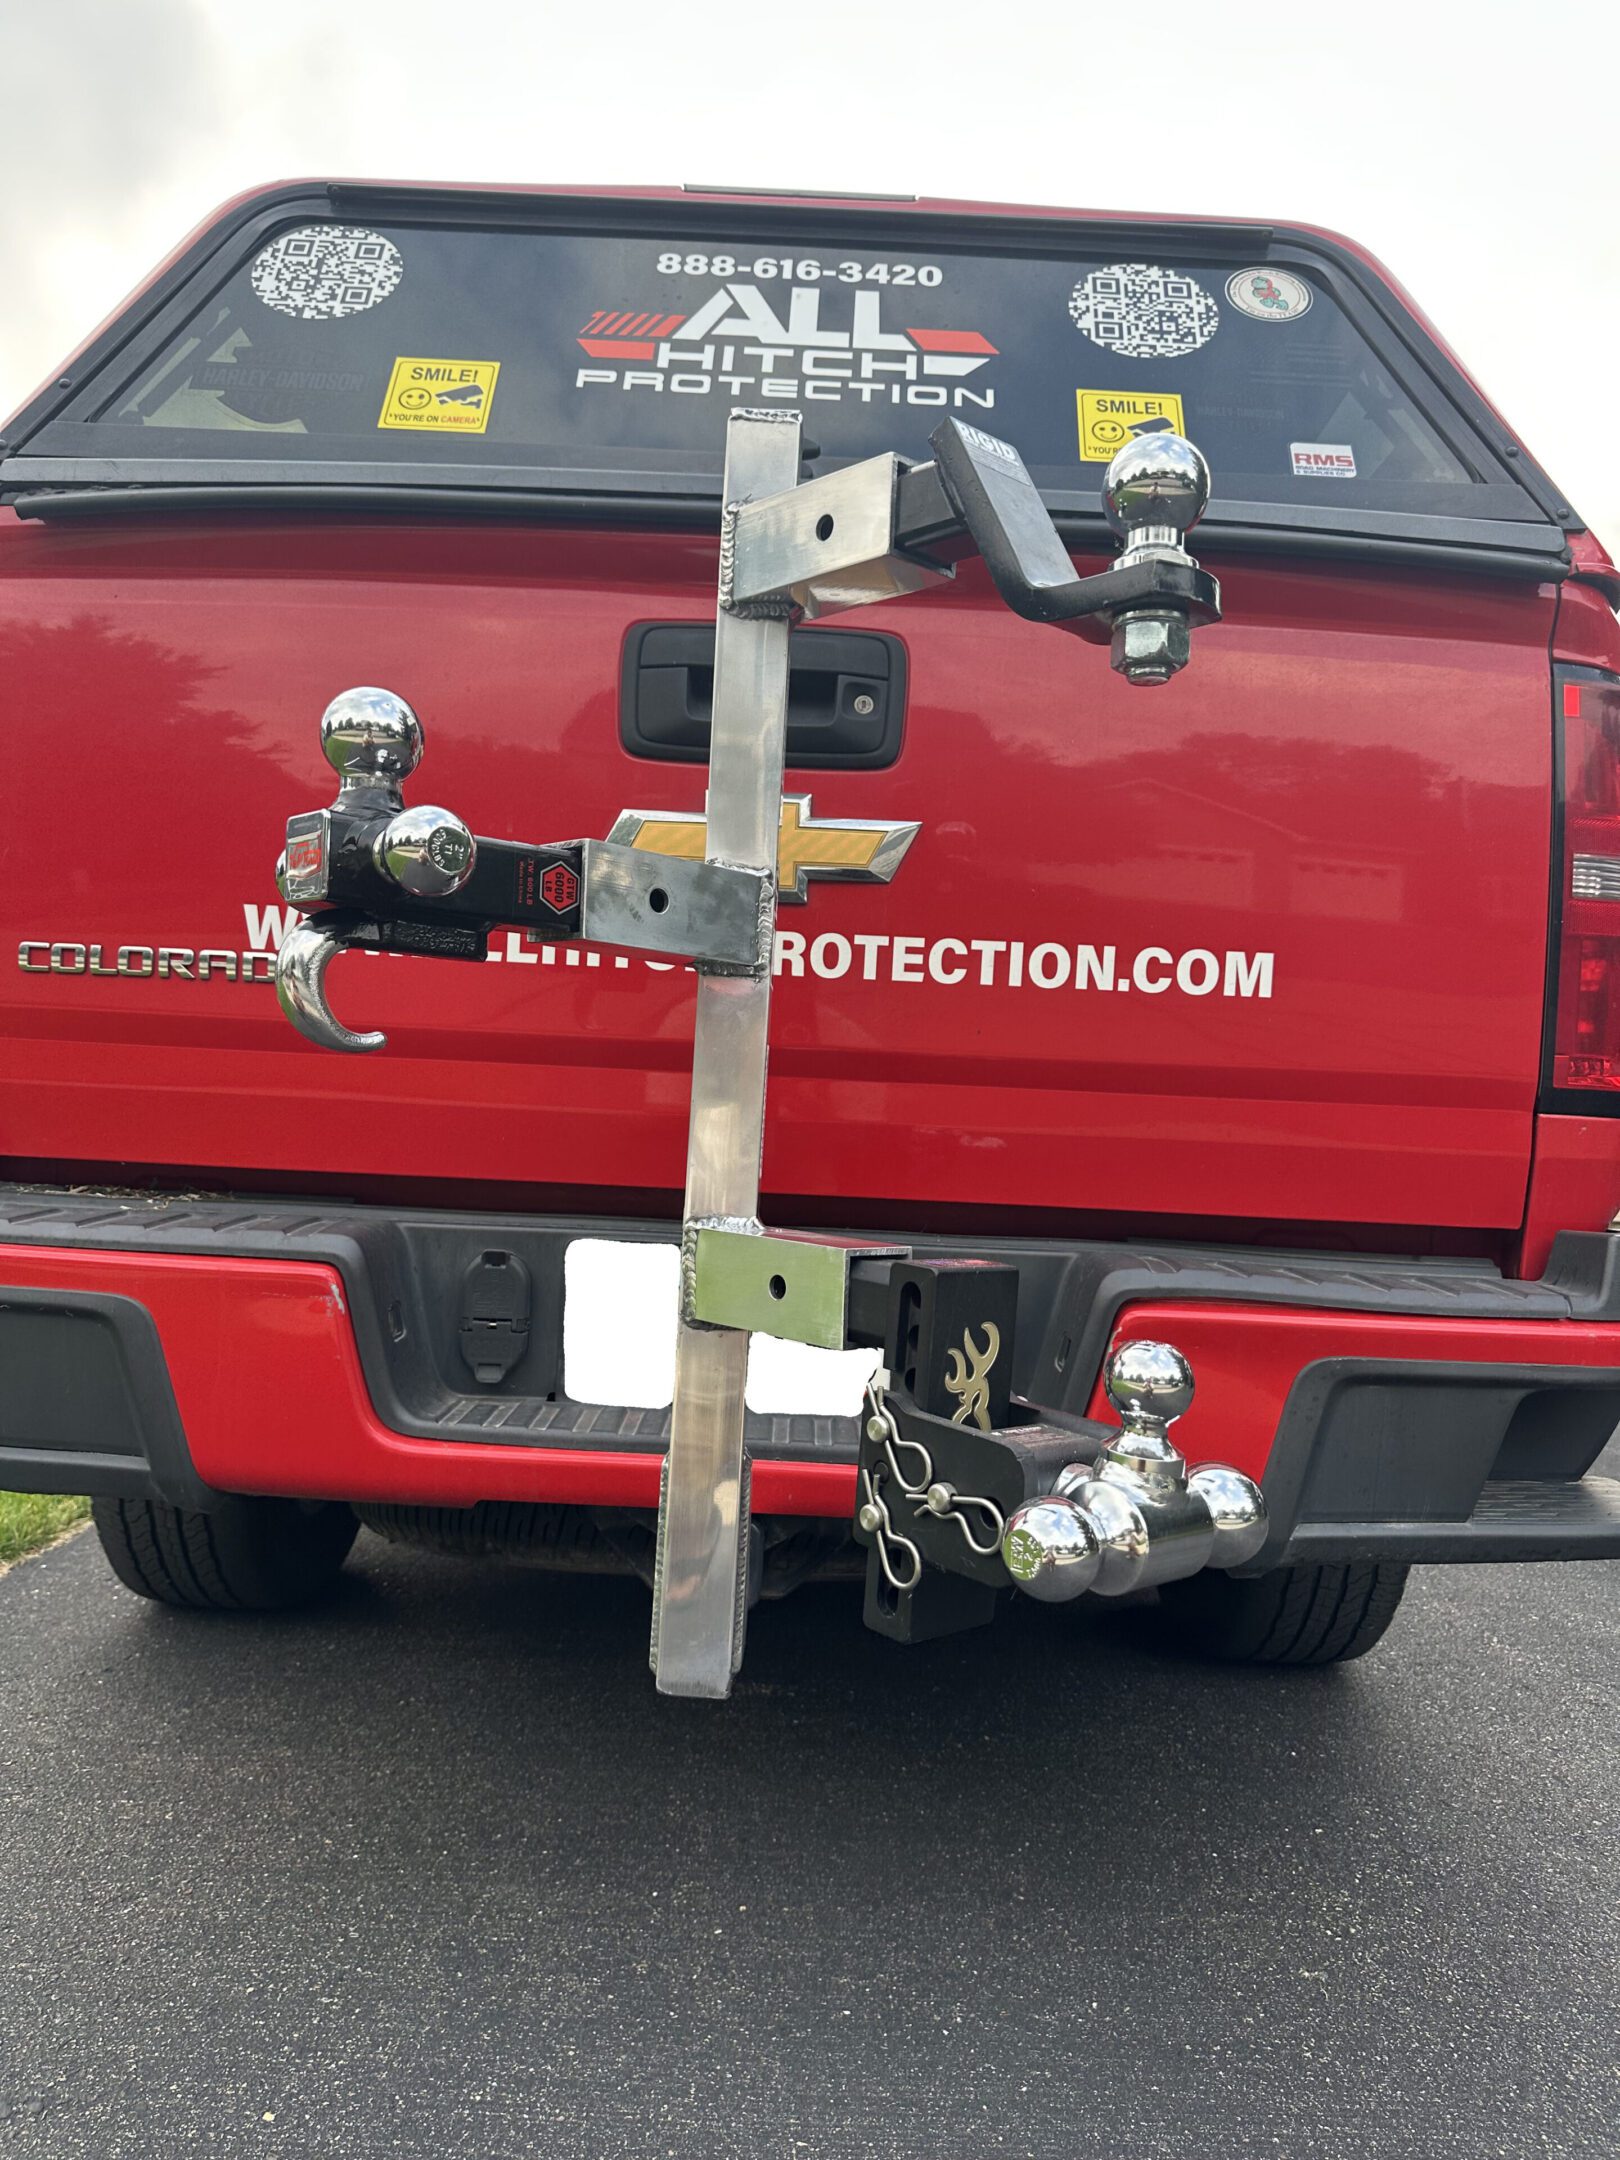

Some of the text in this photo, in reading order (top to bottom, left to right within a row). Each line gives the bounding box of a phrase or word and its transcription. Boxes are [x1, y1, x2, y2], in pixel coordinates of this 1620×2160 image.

[656, 252, 943, 288] 888-616-3420
[671, 283, 918, 351] ALL
[411, 366, 479, 383] SMILE!
[656, 342, 918, 381] HITCH
[575, 368, 996, 409] PROTECTION
[426, 415, 440, 423] ON
[1096, 399, 1163, 415] SMILE!
[955, 420, 1016, 461] RIGID
[1093, 446, 1121, 455] YOU'R
[1294, 453, 1354, 467] RMS
[554, 871, 565, 903] 6000
[566, 877, 575, 901] GTW
[17, 940, 278, 982] COLORAD
